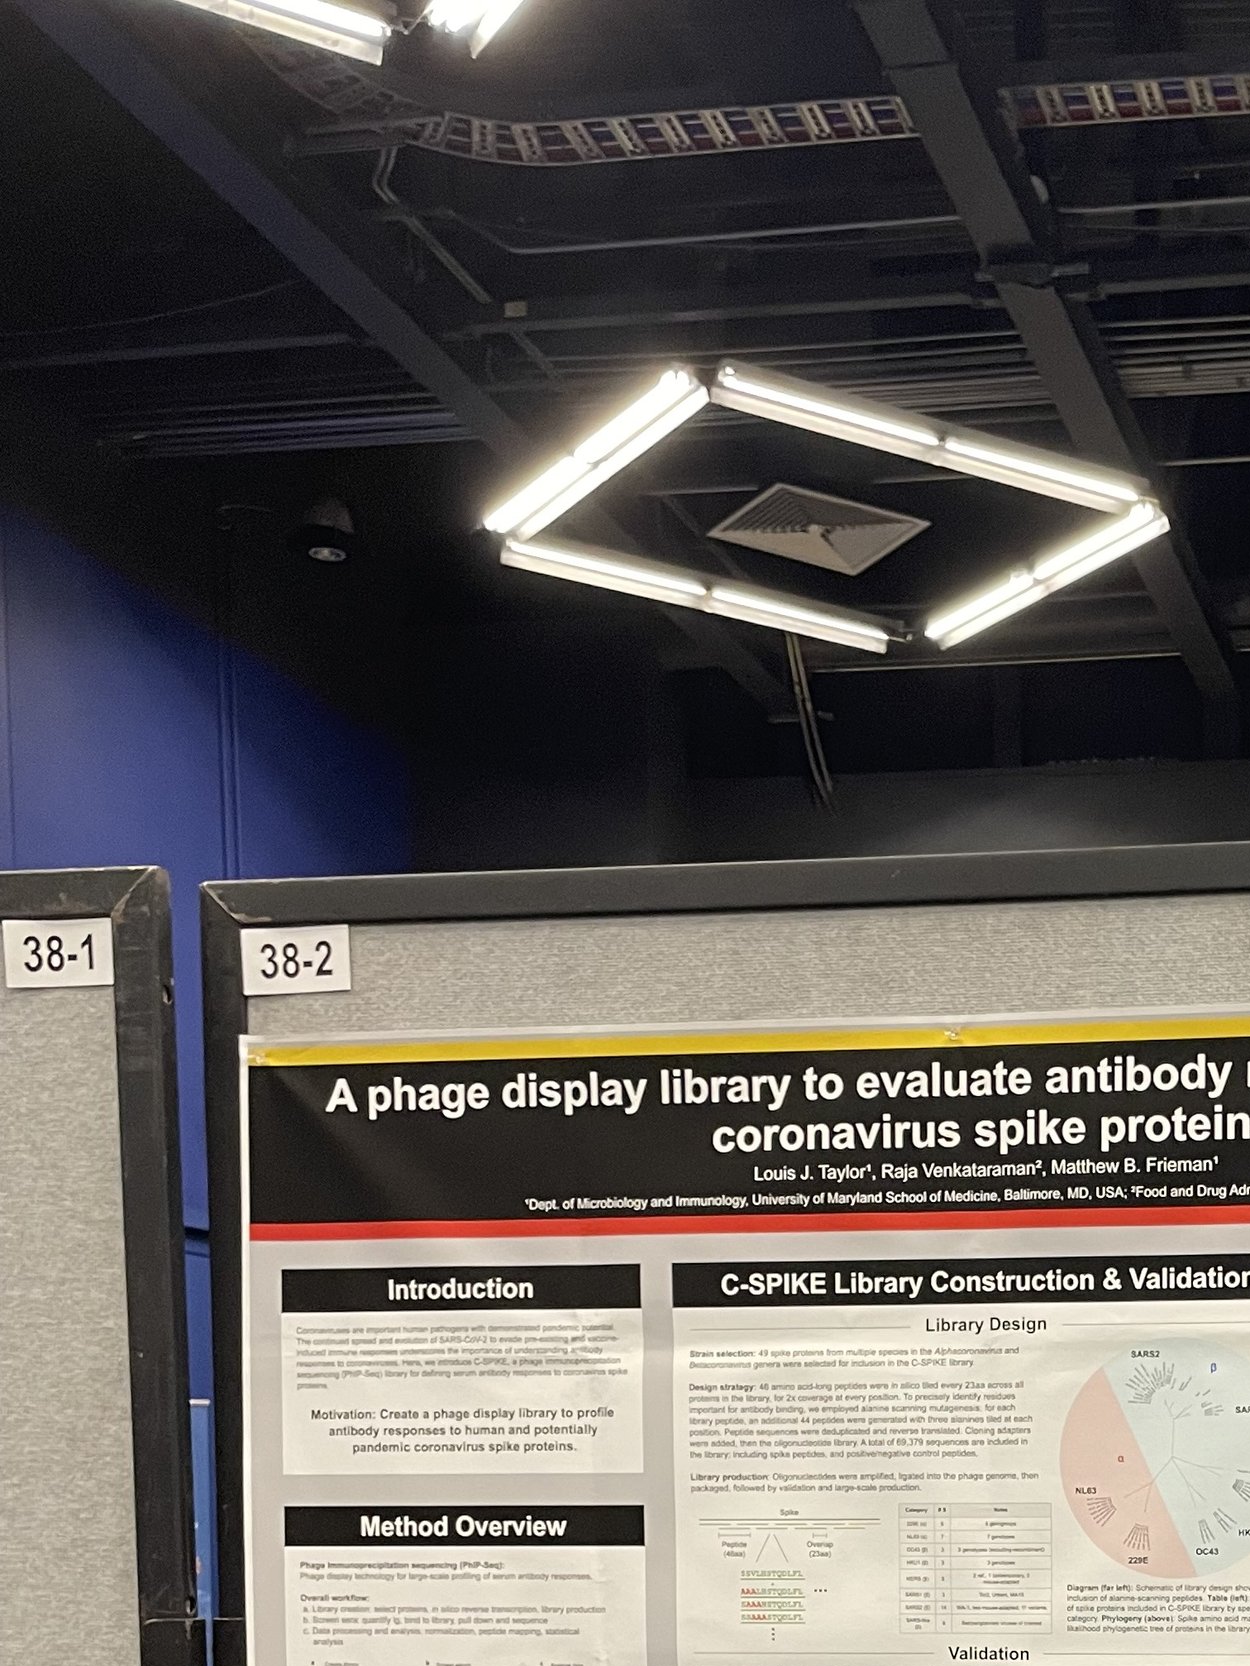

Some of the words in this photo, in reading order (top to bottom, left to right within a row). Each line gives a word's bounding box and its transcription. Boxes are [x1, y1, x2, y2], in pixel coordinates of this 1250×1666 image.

[24, 934, 93, 972] 38-1
[260, 941, 332, 978] 38-2
[325, 1078, 357, 1112] A
[368, 1076, 489, 1120] phage
[502, 1071, 647, 1115] display
[660, 1068, 791, 1110] library
[803, 1067, 843, 1100] to
[856, 1061, 1031, 1099] evaluate
[1045, 1053, 1232, 1098] antibody
[713, 1113, 960, 1152] coronavirus
[974, 1109, 1086, 1153] spike
[754, 1165, 796, 1181] Louis
[800, 1165, 813, 1180] J.
[881, 1163, 918, 1182] Raja
[1051, 1159, 1119, 1174] Matthew
[1124, 1157, 1140, 1172] B.
[562, 1198, 575, 1209] of
[577, 1197, 648, 1210] Microbiology
[650, 1195, 672, 1207] and
[675, 1194, 748, 1208] Immunology,
[752, 1193, 810, 1207] University
[812, 1192, 825, 1204] of
[827, 1191, 882, 1206] Maryland
[885, 1191, 926, 1203] School
[929, 1190, 942, 1202] of
[944, 1190, 1000, 1202] Medicine,
[1004, 1188, 1063, 1200] Baltimore,
[1067, 1186, 1092, 1200] MD,
[1096, 1186, 1127, 1199] USA;
[1170, 1185, 1193, 1197] and
[1197, 1184, 1226, 1199] Drug
[388, 1277, 533, 1300] Introduction
[721, 1272, 826, 1295] C-SPIKE
[835, 1272, 923, 1298] Library
[931, 1269, 1094, 1292] Construction
[1103, 1267, 1122, 1290] &
[926, 1318, 983, 1334] Library
[990, 1317, 1046, 1333] Design
[1131, 1350, 1160, 1358] SARS2
[311, 1409, 375, 1419] Motivation:
[380, 1408, 419, 1419] Create
[423, 1411, 429, 1419] a
[433, 1408, 469, 1421] phage
[473, 1408, 515, 1420] display
[519, 1408, 557, 1420] library
[561, 1408, 573, 1418] to
[577, 1407, 614, 1420] profile
[329, 1426, 379, 1438] antibody
[384, 1427, 446, 1438] responses
[450, 1426, 461, 1435] to
[465, 1425, 504, 1435] human
[508, 1424, 530, 1434] and
[534, 1424, 597, 1437] potentially
[352, 1442, 410, 1454] pandemic
[414, 1441, 484, 1452] coronavirus
[488, 1441, 519, 1453] spike
[524, 1441, 576, 1453] proteins.
[360, 1515, 448, 1536] Method
[455, 1515, 566, 1536] Overview
[1128, 1556, 1148, 1564] 229E
[948, 1646, 1028, 1660] Validation
